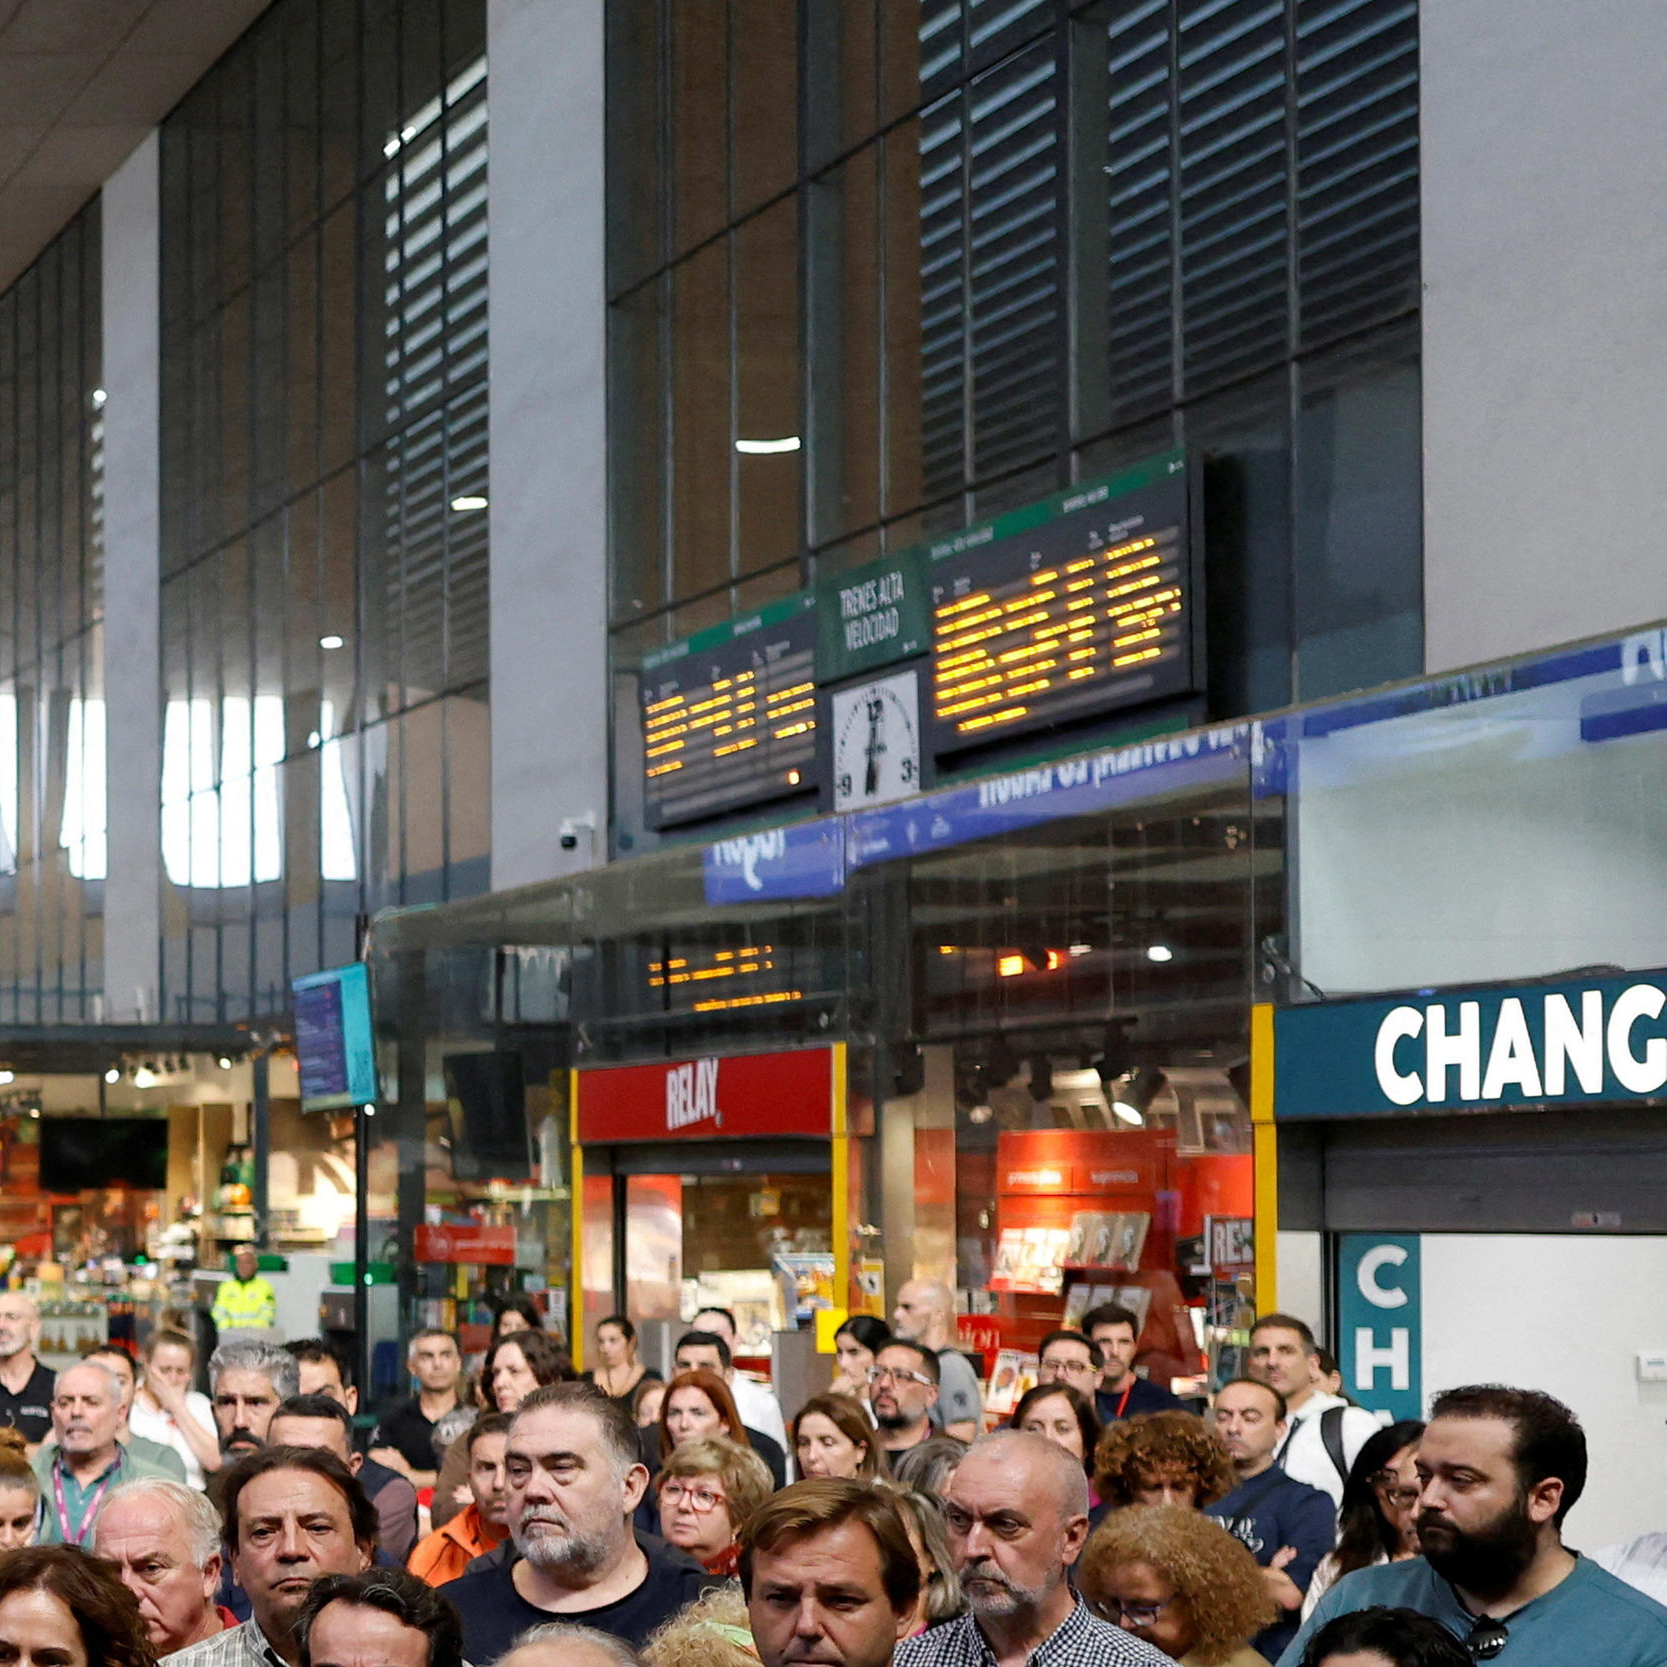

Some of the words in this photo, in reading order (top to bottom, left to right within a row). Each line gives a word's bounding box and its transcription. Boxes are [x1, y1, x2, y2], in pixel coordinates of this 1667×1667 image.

[839, 579, 877, 618] TRENES
[878, 571, 905, 607] ALTA
[844, 607, 900, 651] VELOCIDAD
[666, 1057, 720, 1131] RELAY
